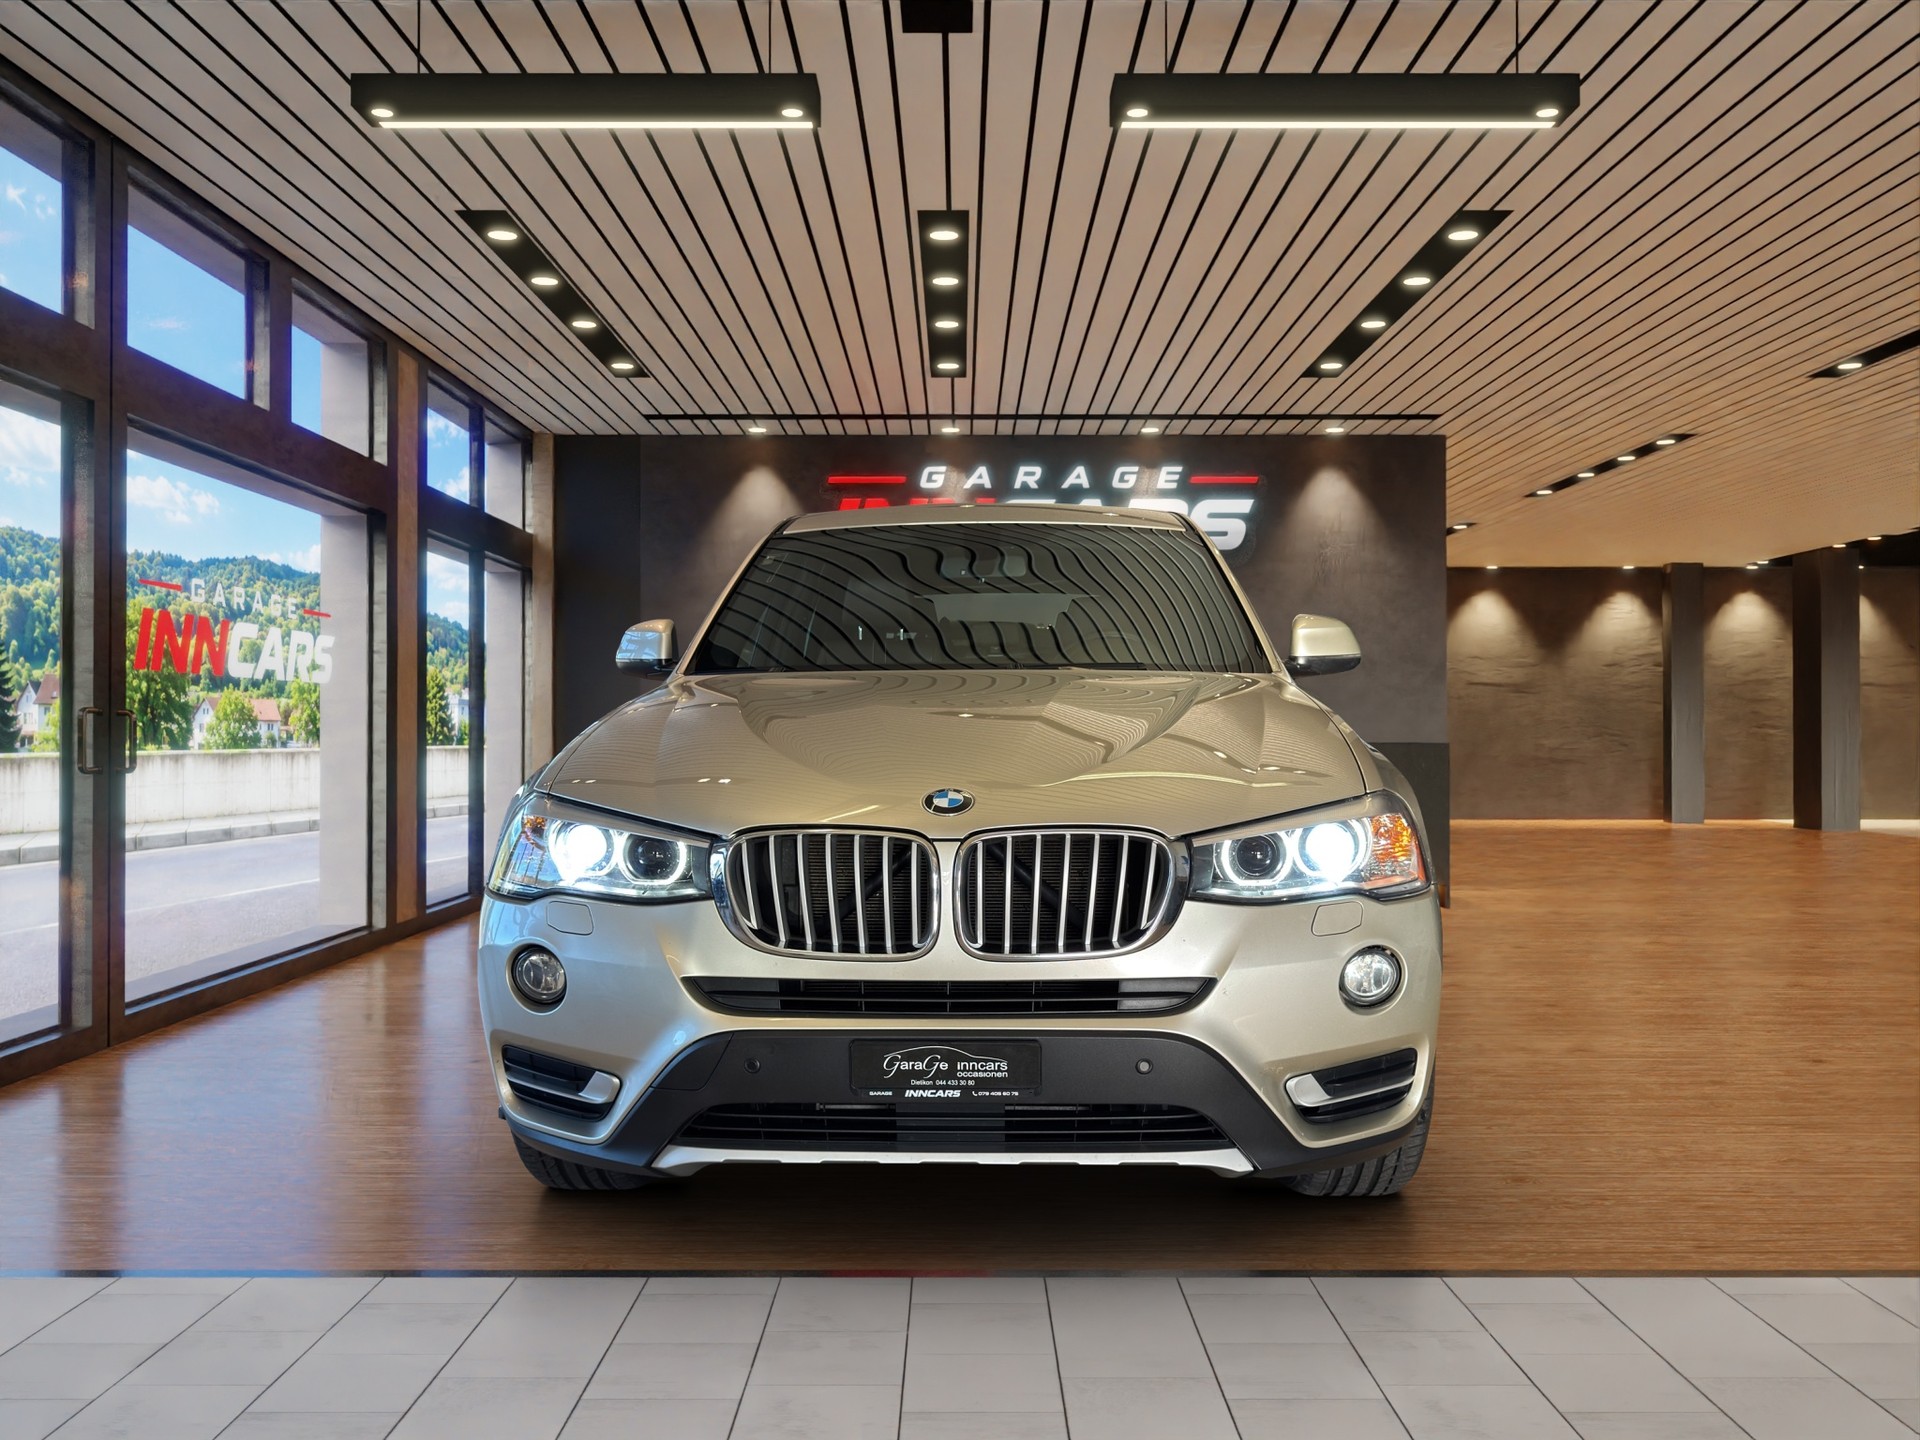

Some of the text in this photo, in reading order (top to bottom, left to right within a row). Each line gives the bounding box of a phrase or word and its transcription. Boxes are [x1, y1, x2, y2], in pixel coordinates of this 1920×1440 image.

[919, 466, 1184, 489] GARAGE
[190, 578, 298, 619] GARAGE
[134, 607, 335, 684] INNCARS
[956, 1060, 1008, 1071] inncars
[904, 1089, 961, 1098] INNCARS
